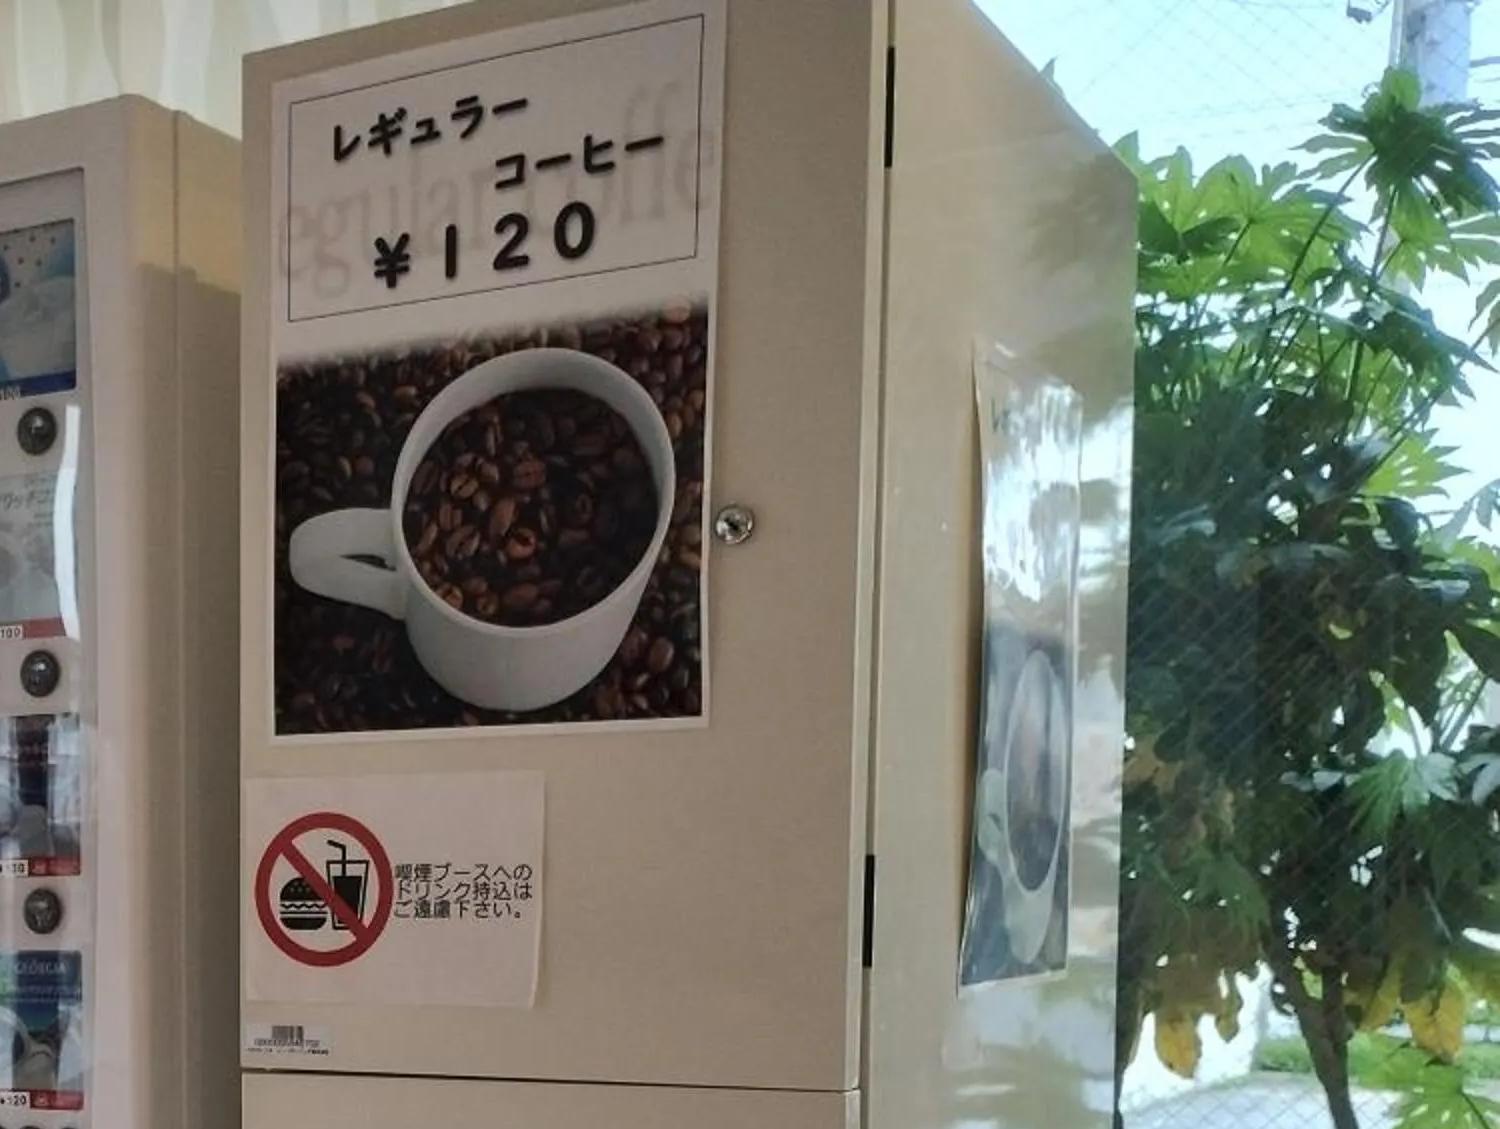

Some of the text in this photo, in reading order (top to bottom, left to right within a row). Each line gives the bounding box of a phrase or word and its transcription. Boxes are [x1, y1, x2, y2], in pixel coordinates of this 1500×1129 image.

[332, 95, 529, 162] レギュラー
[494, 133, 665, 190] コーヒー
[394, 863, 534, 882] 喫煙ブースへの
[395, 881, 534, 901] ドリンク持込は
[393, 900, 523, 919] ご遠慮下さい。
